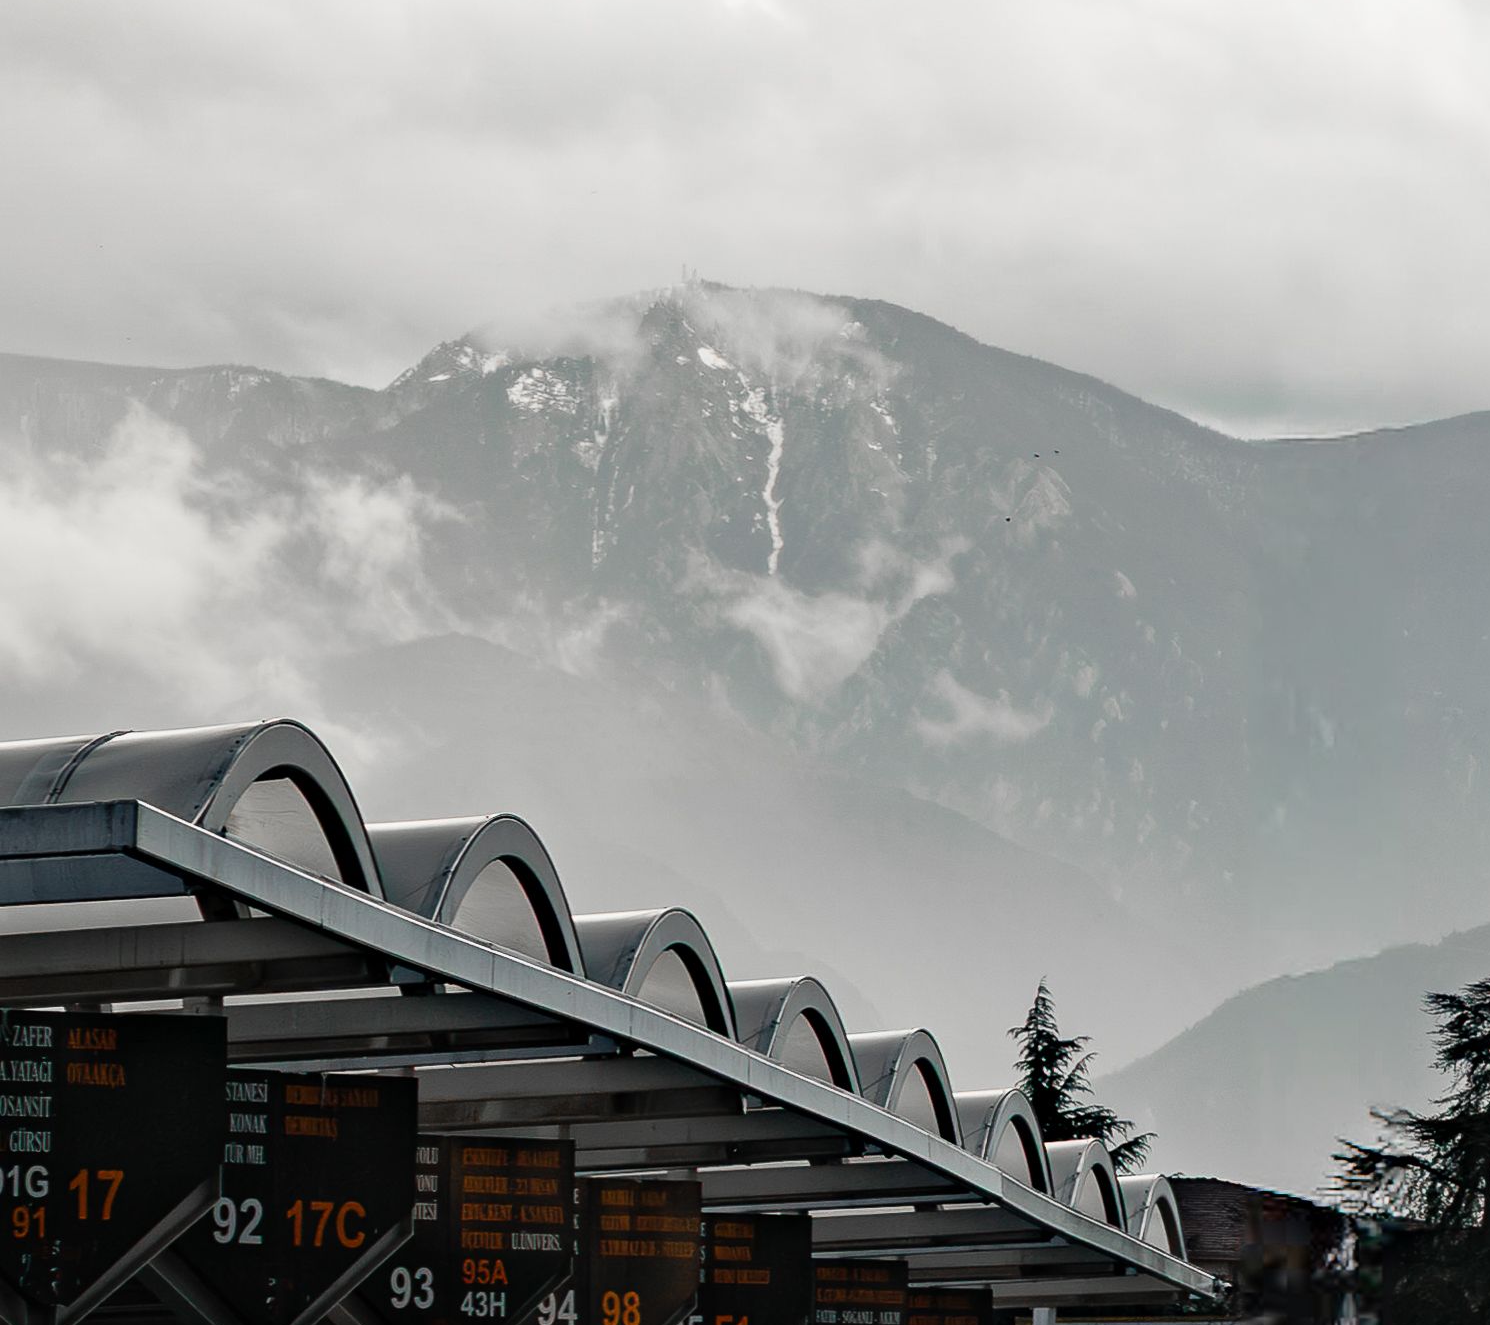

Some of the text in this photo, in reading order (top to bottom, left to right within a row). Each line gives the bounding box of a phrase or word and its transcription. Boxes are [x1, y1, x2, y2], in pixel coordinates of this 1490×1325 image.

[12, 1025, 53, 1048] ZAFER
[9, 1127, 53, 1153] GÜRSU
[229, 1112, 268, 1135] KONAK
[0, 1165, 50, 1199] 1G
[68, 1168, 125, 1221] 17
[10, 1205, 48, 1240] 91
[212, 1196, 264, 1246] 92
[285, 1199, 367, 1249] 17C
[389, 1267, 436, 1310] 93
[462, 1258, 510, 1286] 95A
[459, 1291, 507, 1318] 43H
